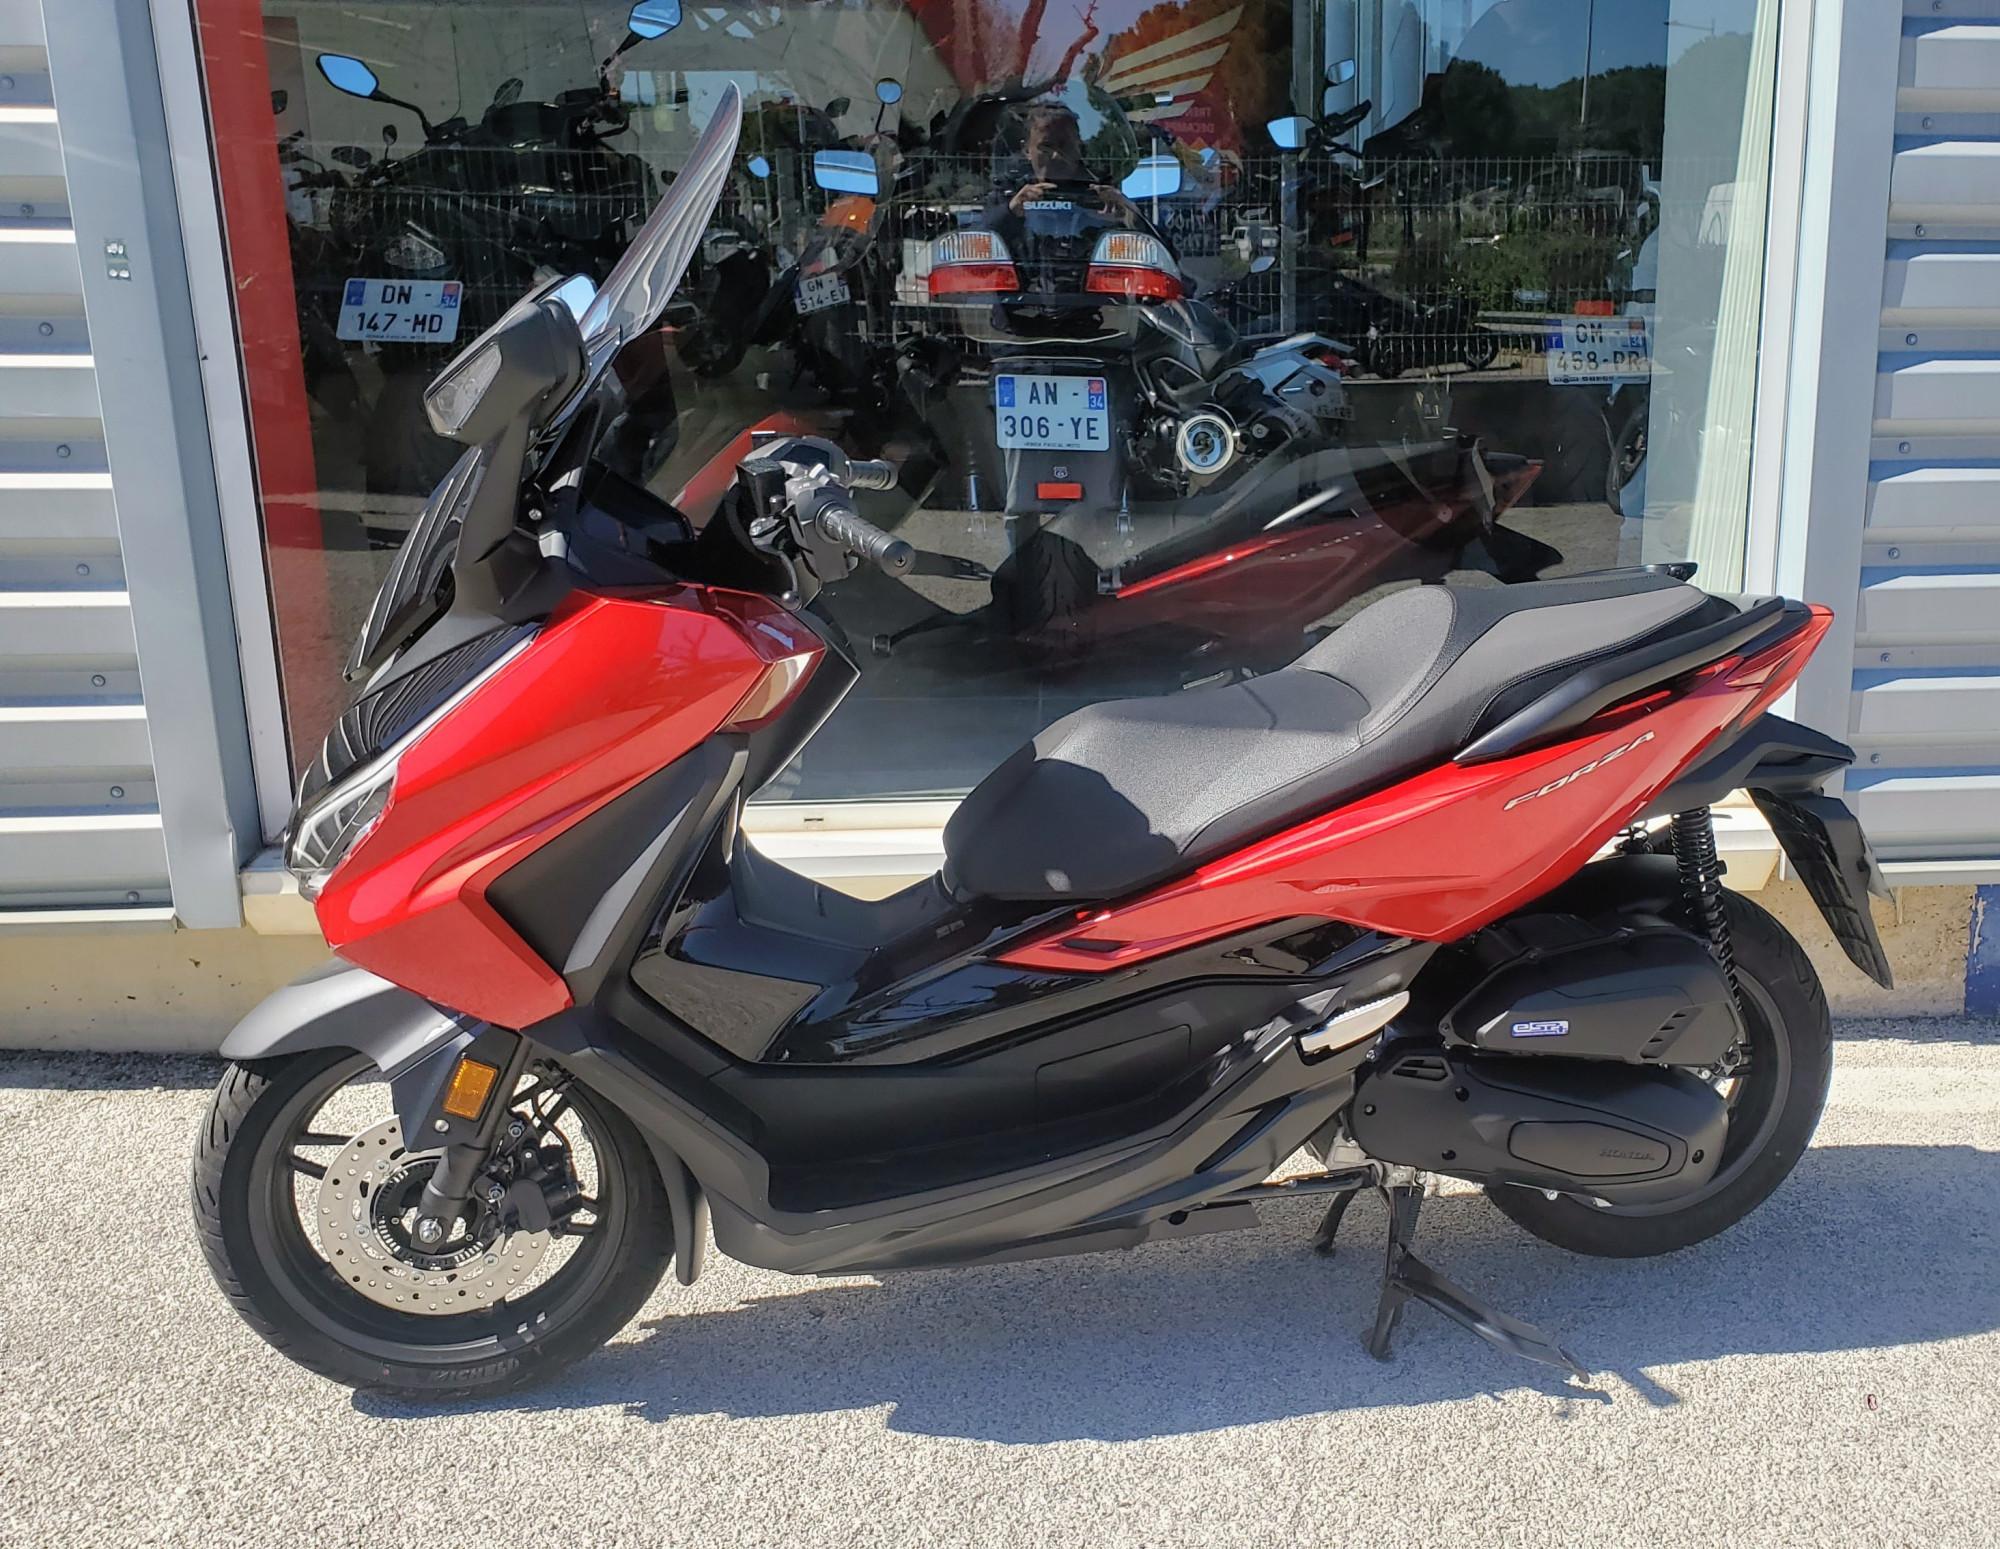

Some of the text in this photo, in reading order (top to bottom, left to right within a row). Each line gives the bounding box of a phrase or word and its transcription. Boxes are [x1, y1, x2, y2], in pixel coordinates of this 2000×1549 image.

[1023, 201, 1072, 210] SUZUKI
[807, 278, 824, 292] GN
[381, 285, 412, 305] DN
[442, 295, 456, 307] 34
[1029, 382, 1058, 405] AN
[1090, 396, 1103, 408] 34
[1004, 415, 1099, 440] 306-YE
[1503, 730, 1655, 811] FORZA
[1599, 1149, 1655, 1161] HONDA
